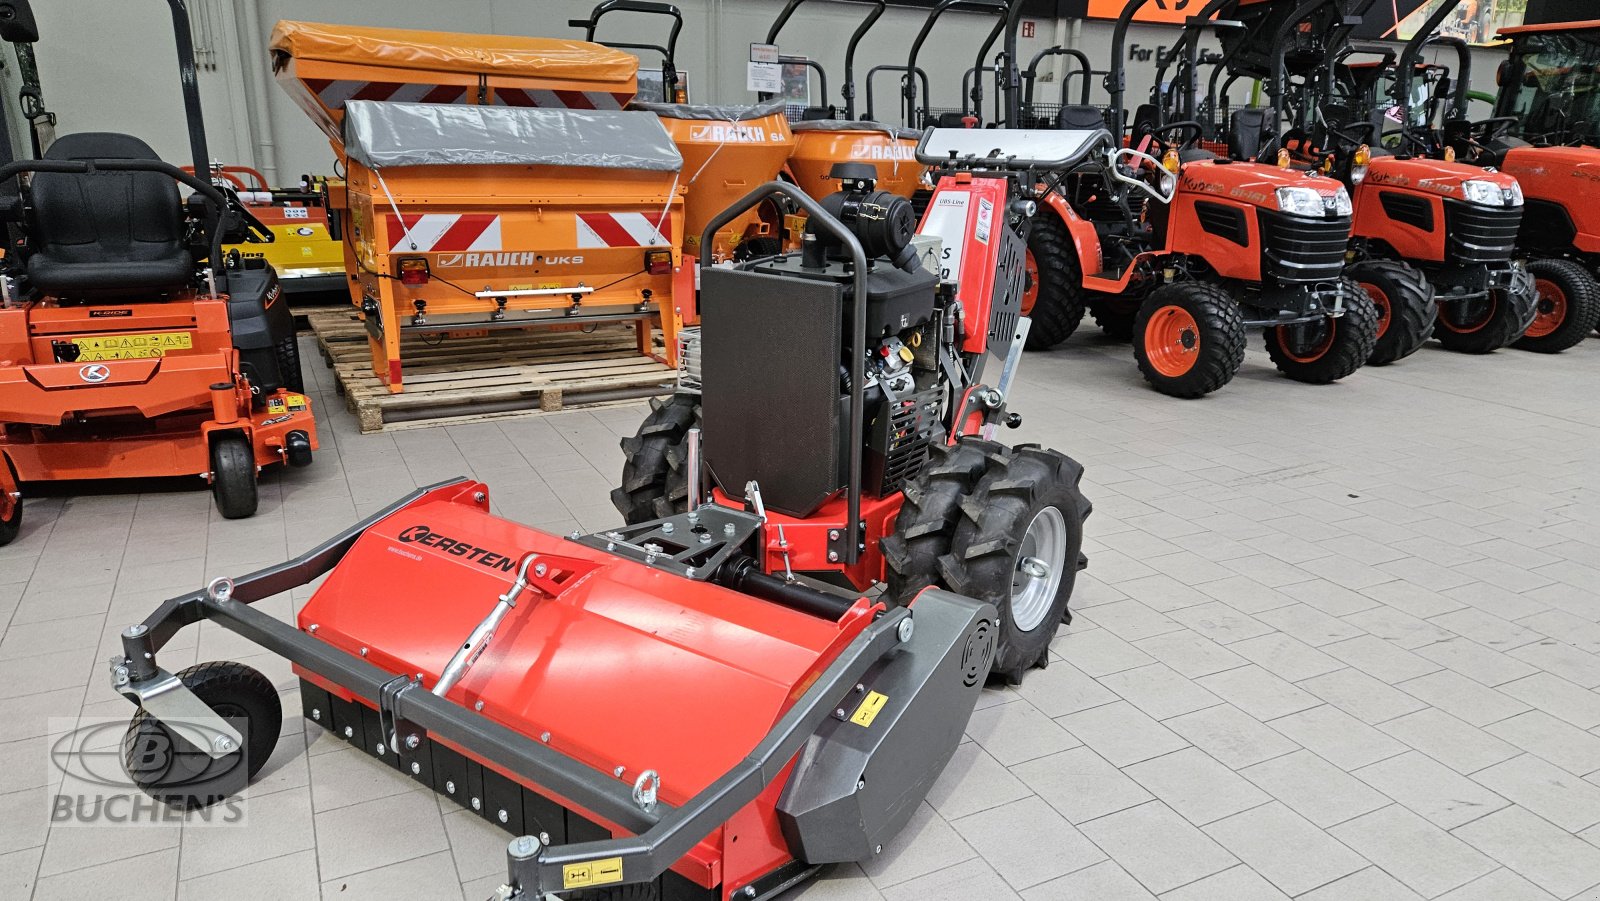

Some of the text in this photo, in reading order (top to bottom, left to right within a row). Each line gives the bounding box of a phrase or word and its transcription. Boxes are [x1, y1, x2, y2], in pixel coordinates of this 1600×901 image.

[1129, 44, 1153, 62] For
[713, 126, 786, 142] RAUCH SA
[465, 252, 584, 267] RAUCH UKS
[398, 525, 517, 573] KERSTEN
